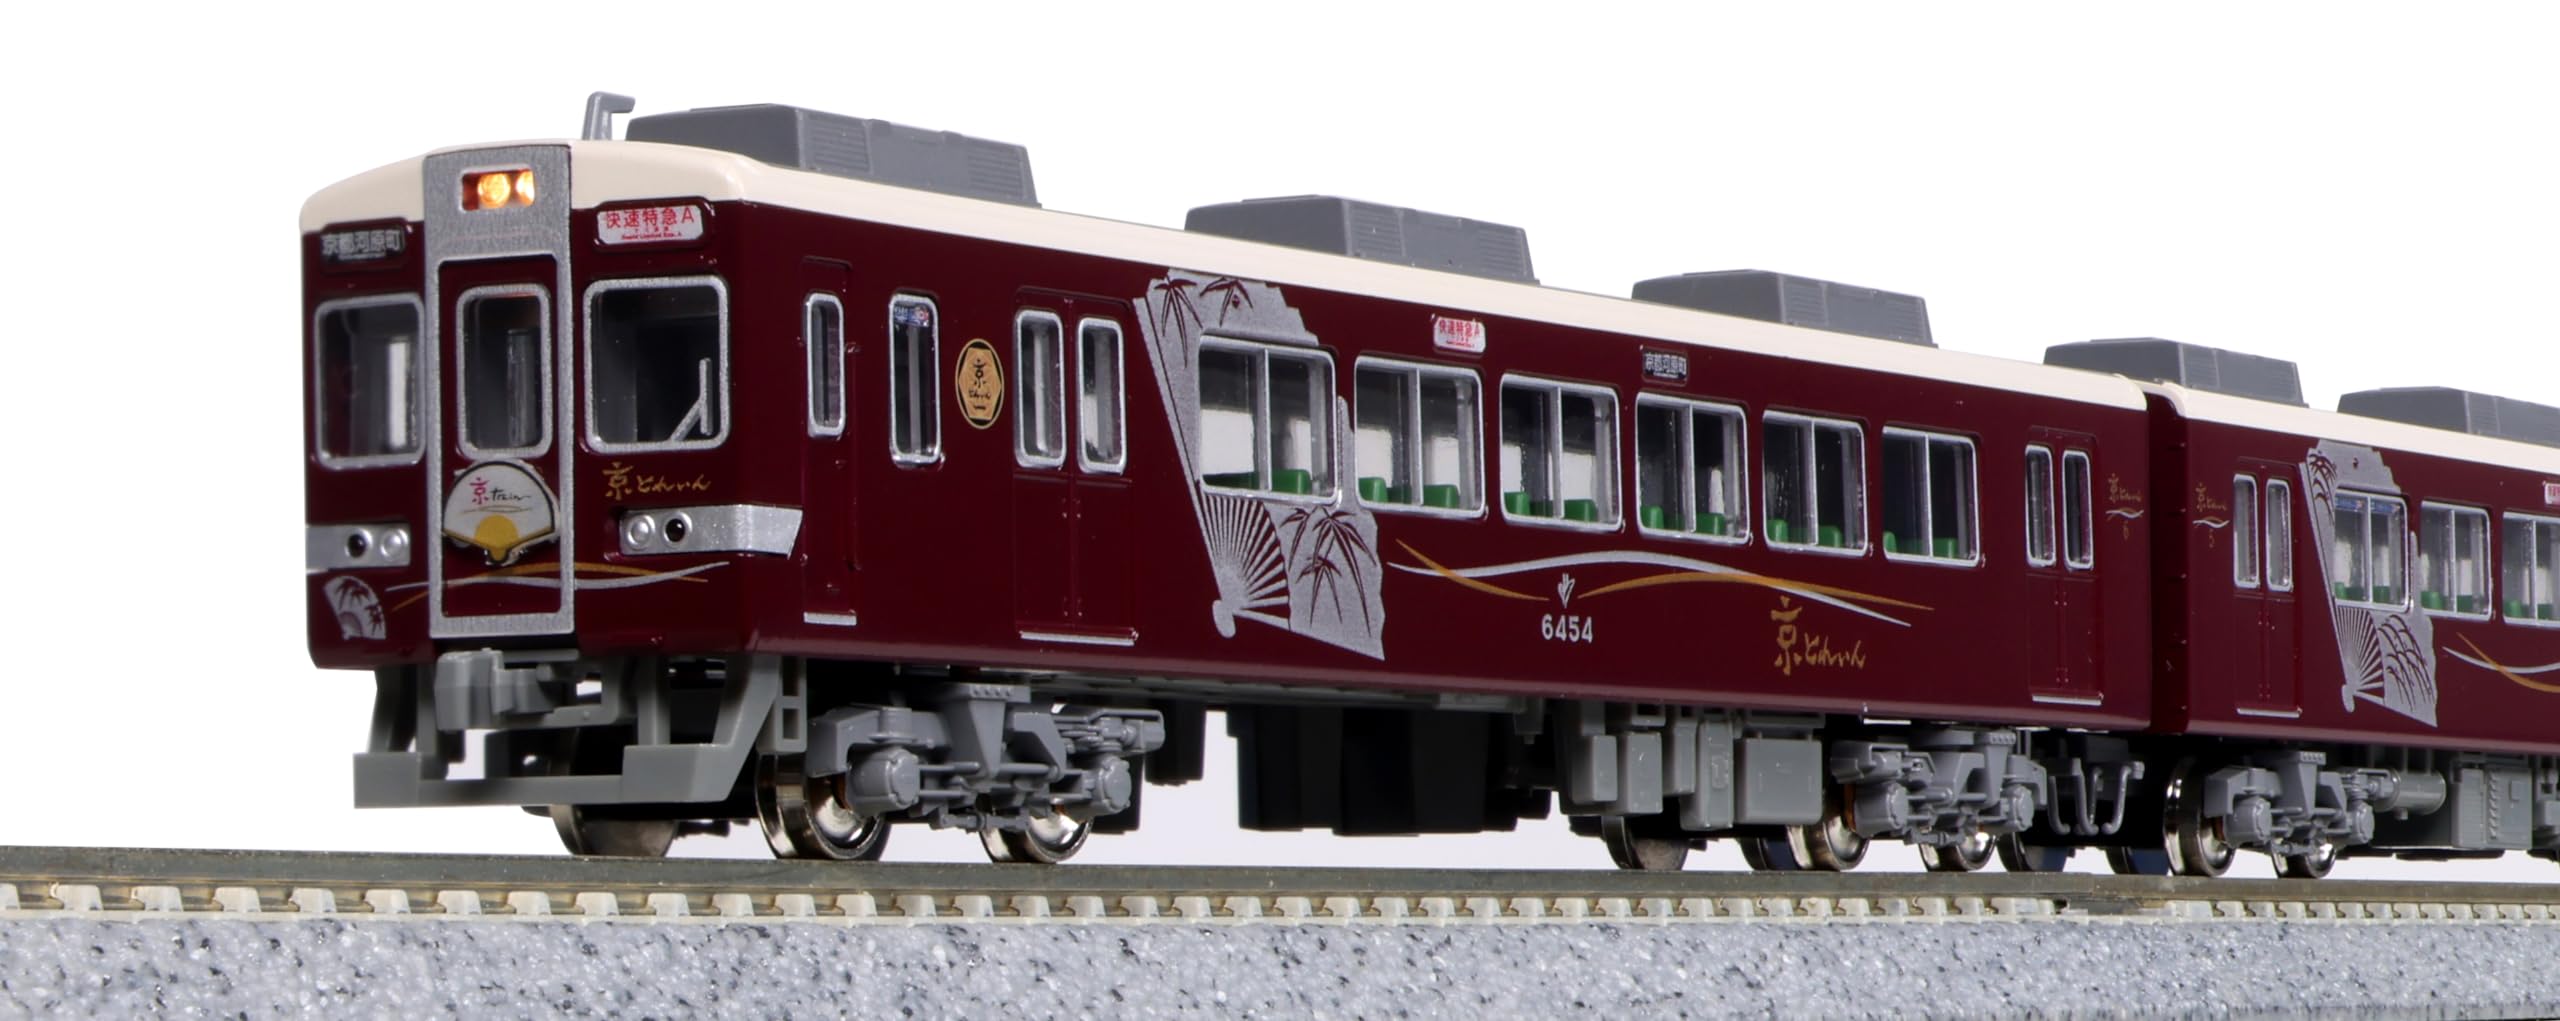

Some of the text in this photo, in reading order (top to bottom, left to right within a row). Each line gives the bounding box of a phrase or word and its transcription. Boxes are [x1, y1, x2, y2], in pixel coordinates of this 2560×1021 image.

[605, 204, 695, 229] 快速特急A
[1541, 613, 1593, 643] 6454
